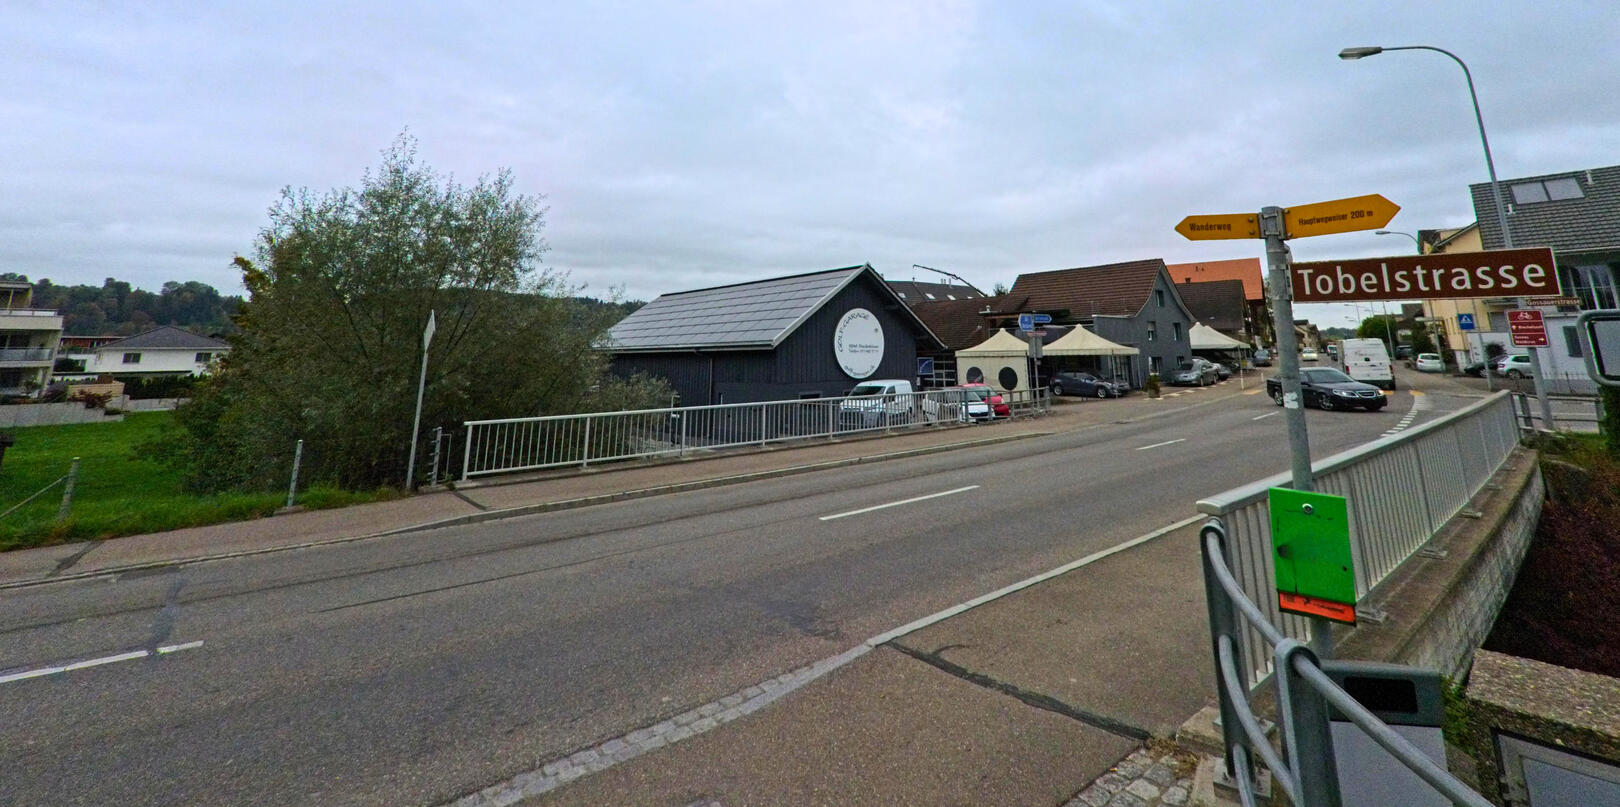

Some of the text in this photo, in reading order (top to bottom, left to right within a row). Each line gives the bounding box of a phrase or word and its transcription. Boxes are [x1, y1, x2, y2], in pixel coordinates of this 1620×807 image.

[1350, 210, 1365, 219] 200
[1189, 221, 1232, 232] Wanderweg
[1297, 262, 1547, 296] Tobelstrasse
